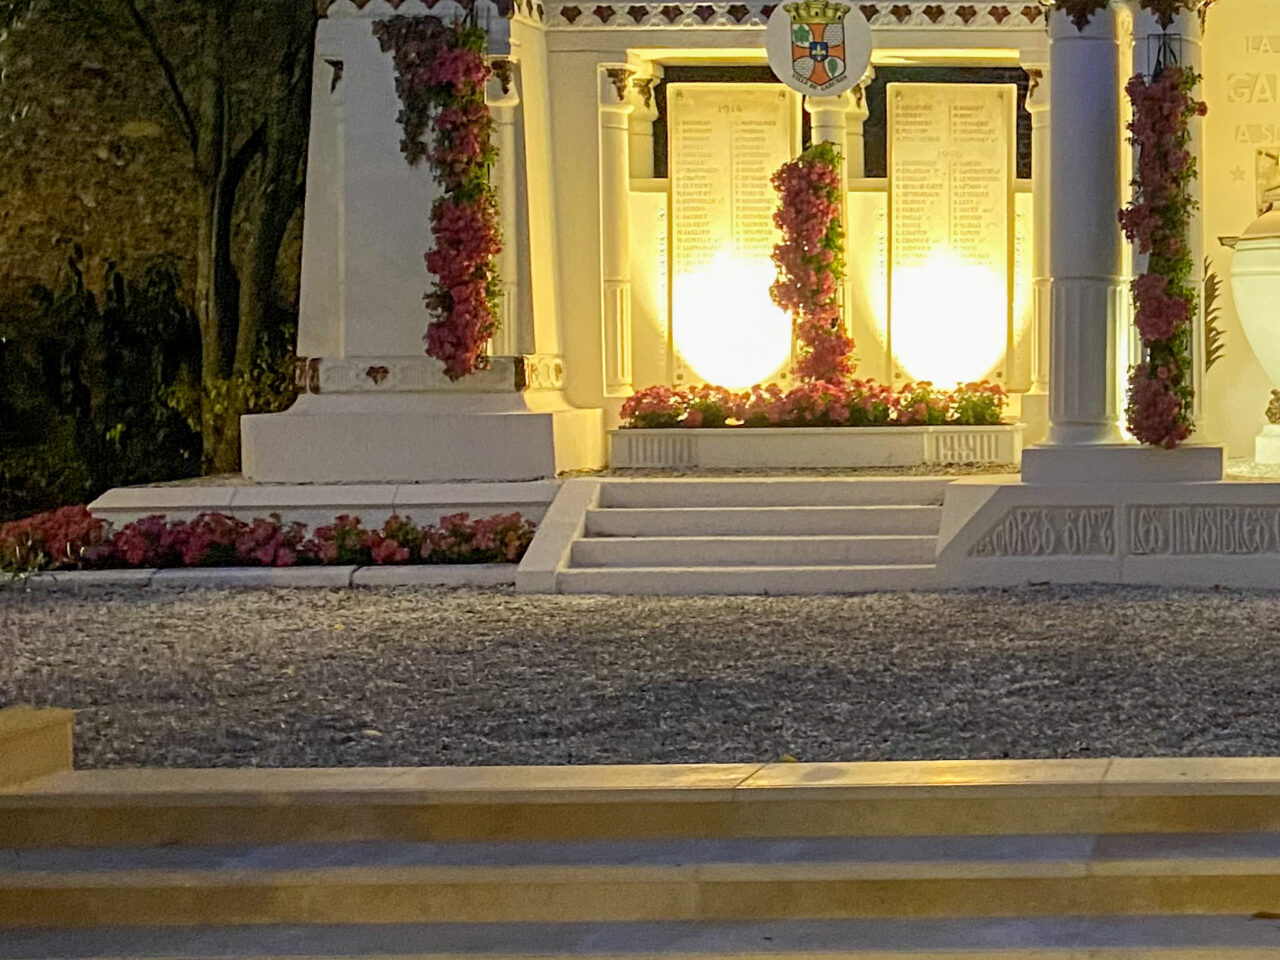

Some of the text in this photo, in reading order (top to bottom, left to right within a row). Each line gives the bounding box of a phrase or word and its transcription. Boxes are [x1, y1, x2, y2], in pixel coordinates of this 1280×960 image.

[1247, 35, 1271, 53] LA
[1235, 124, 1251, 144] A
[1130, 507, 1164, 554] LES
